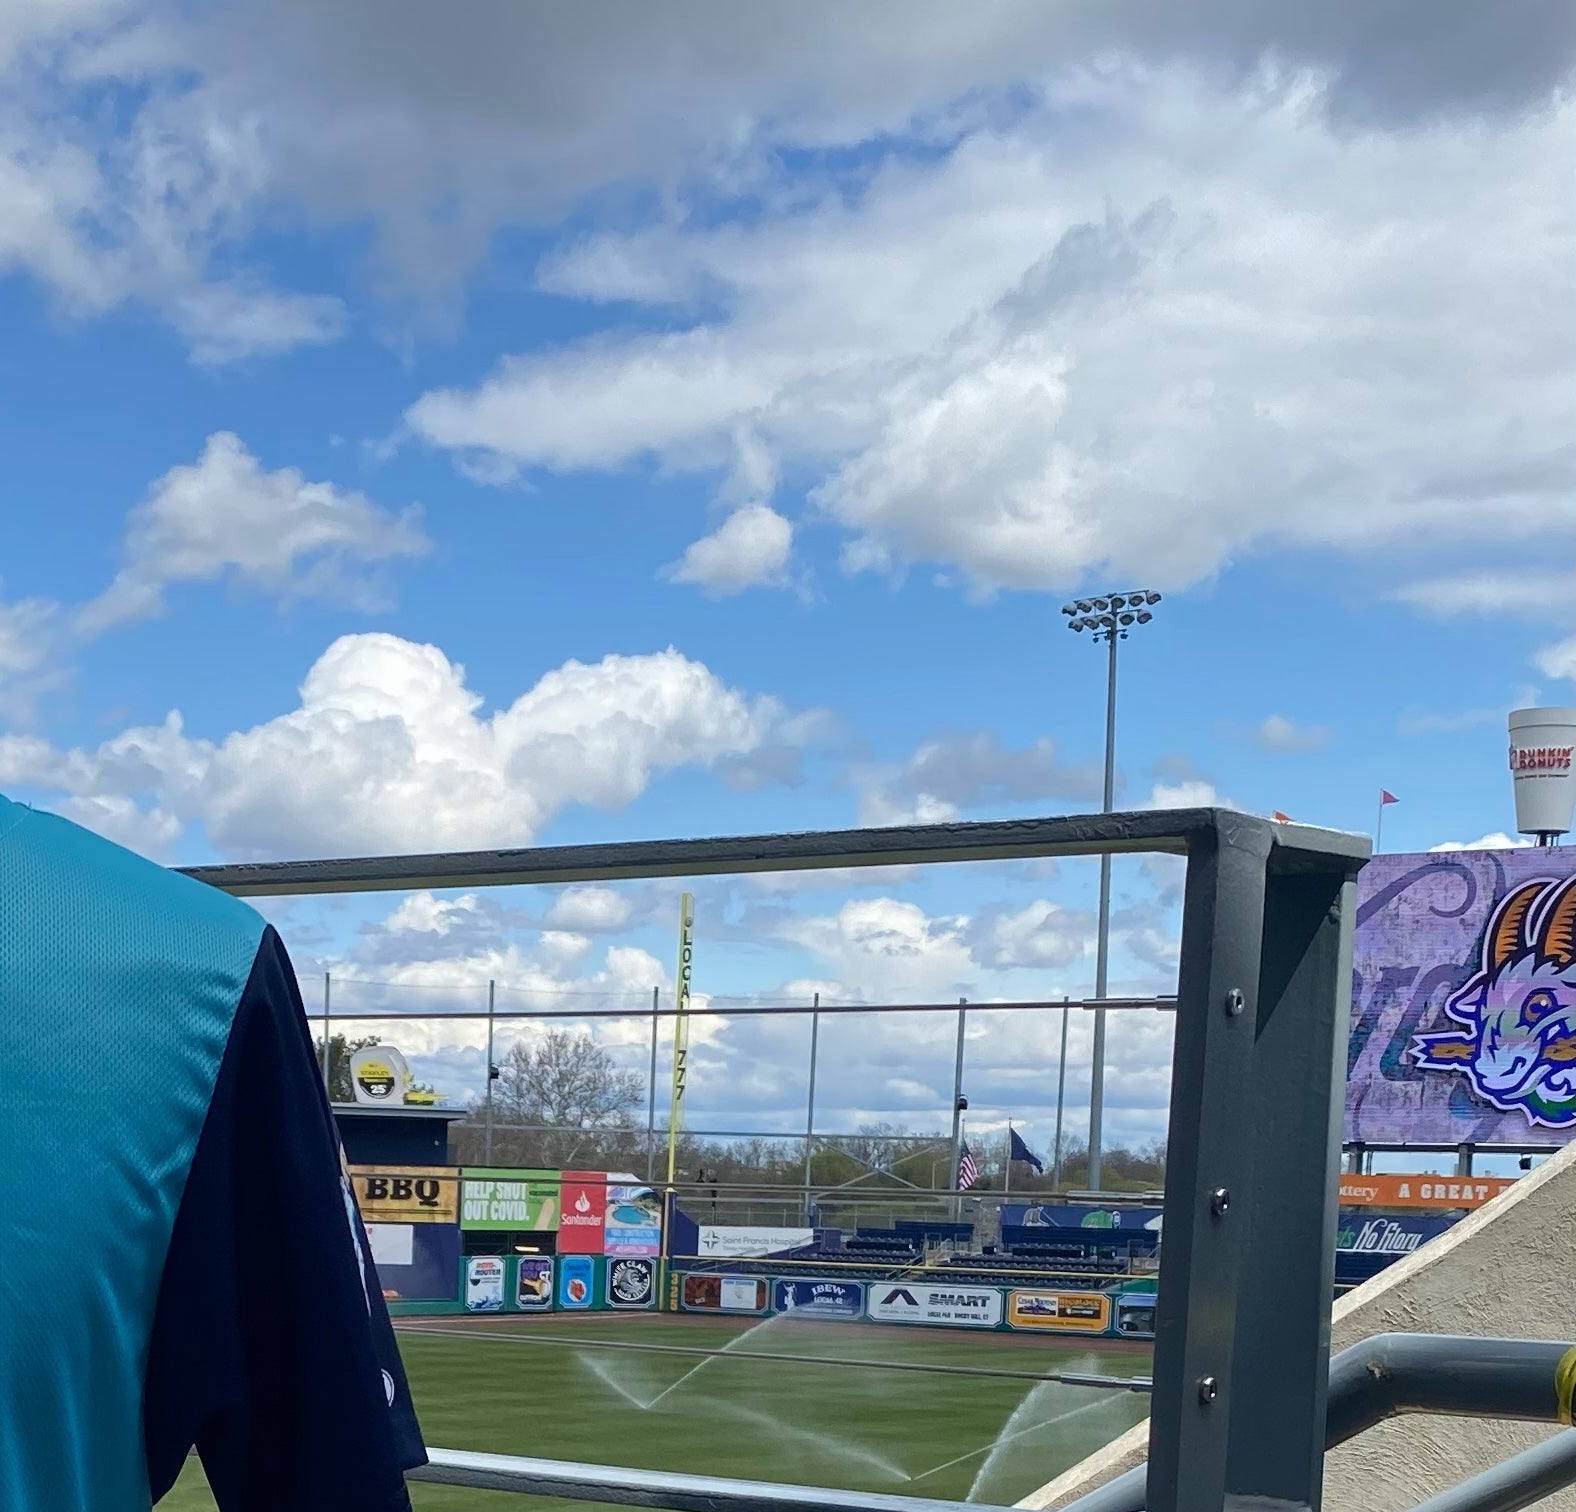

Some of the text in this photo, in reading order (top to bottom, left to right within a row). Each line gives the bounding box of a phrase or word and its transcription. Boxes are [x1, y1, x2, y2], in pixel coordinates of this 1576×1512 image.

[1519, 758, 1571, 769] DONUTS
[676, 1049, 687, 1100] 777
[370, 1084, 387, 1094] 25
[365, 1177, 440, 1207] BBQ
[464, 1181, 495, 1200] HELP
[495, 1182, 528, 1201] SHUT
[1398, 1183, 1411, 1199] A
[1420, 1183, 1489, 1201] GREAT
[463, 1200, 530, 1222] OUT COVID.
[561, 1213, 602, 1226] Santander
[1353, 1218, 1388, 1250] No
[626, 1260, 648, 1274] CLAW
[669, 1273, 679, 1311] 325
[811, 1283, 846, 1296] IBEW
[928, 1293, 991, 1307] SMART
